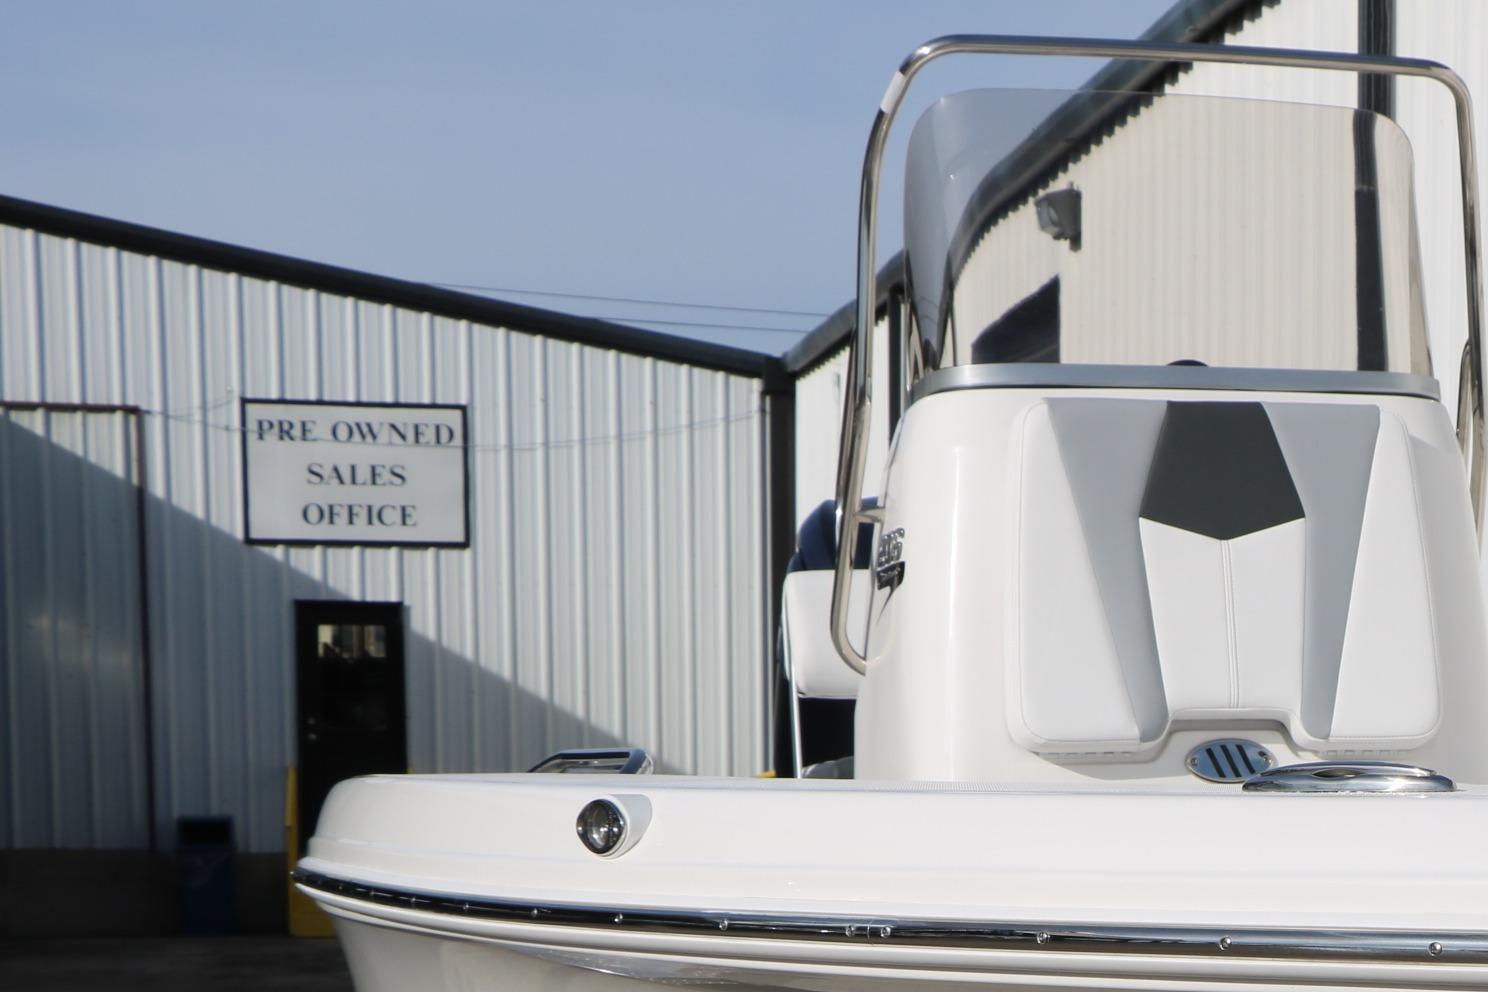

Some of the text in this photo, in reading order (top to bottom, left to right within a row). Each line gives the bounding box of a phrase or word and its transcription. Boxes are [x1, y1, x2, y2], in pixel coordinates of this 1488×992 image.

[257, 419, 455, 445] PRE OWNED
[306, 463, 407, 486] SALES
[302, 503, 416, 527] OFFICE
